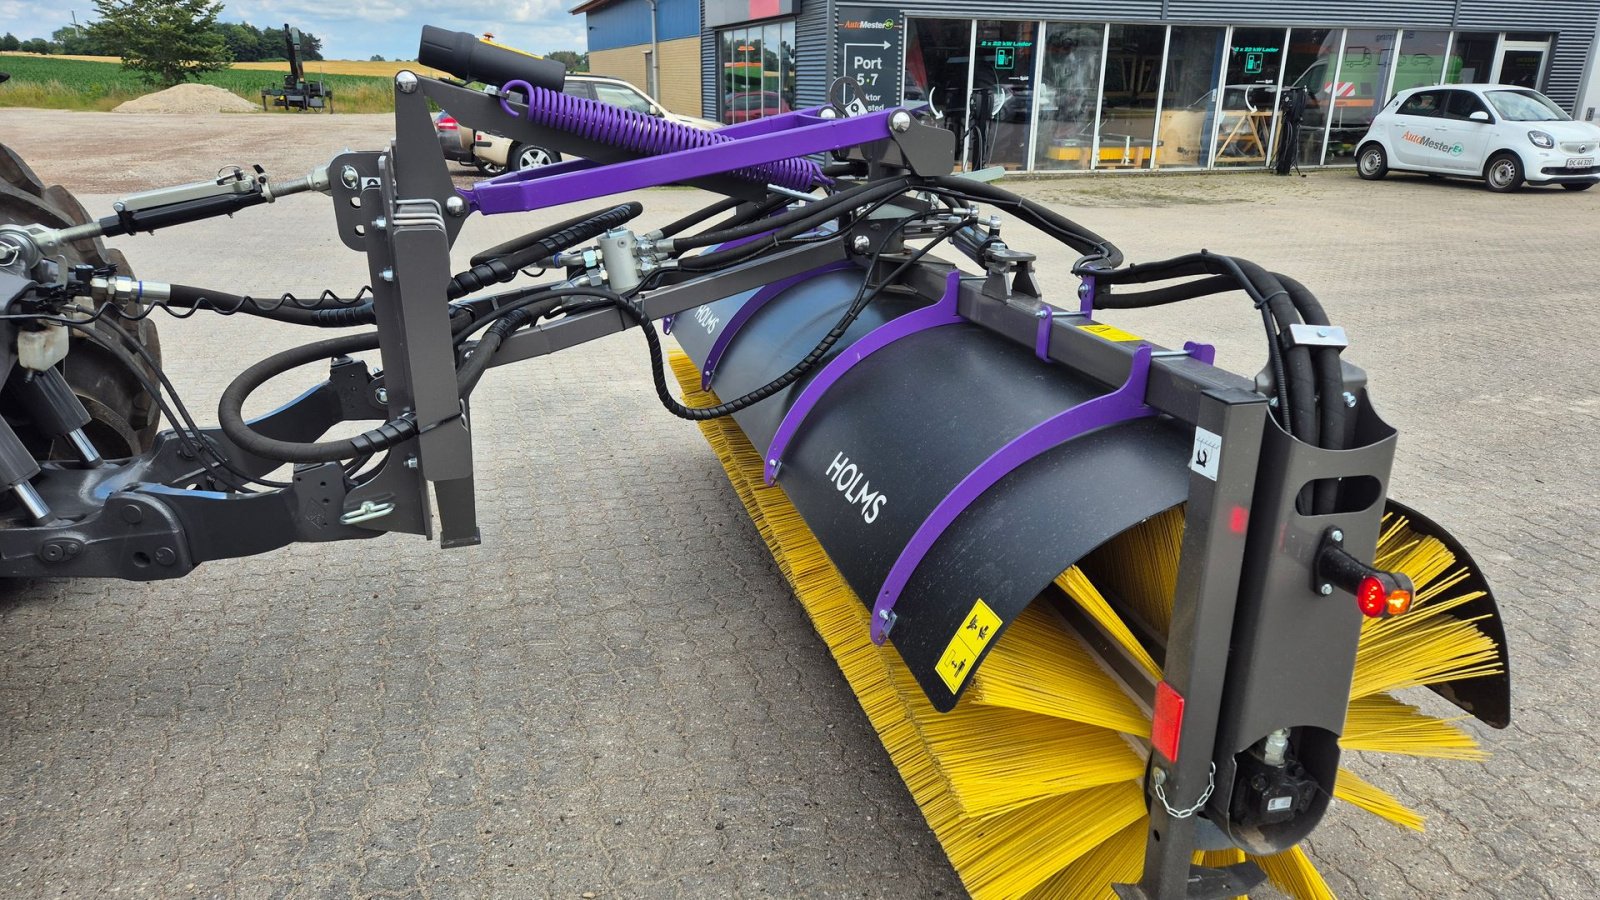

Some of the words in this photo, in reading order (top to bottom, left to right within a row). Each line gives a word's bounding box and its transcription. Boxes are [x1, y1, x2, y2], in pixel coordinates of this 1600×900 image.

[844, 20, 885, 29] AutoMester
[854, 56, 882, 69] Port
[1401, 130, 1454, 153] AutoMester
[694, 304, 720, 335] HOLMS
[825, 450, 888, 524] HOLMS
